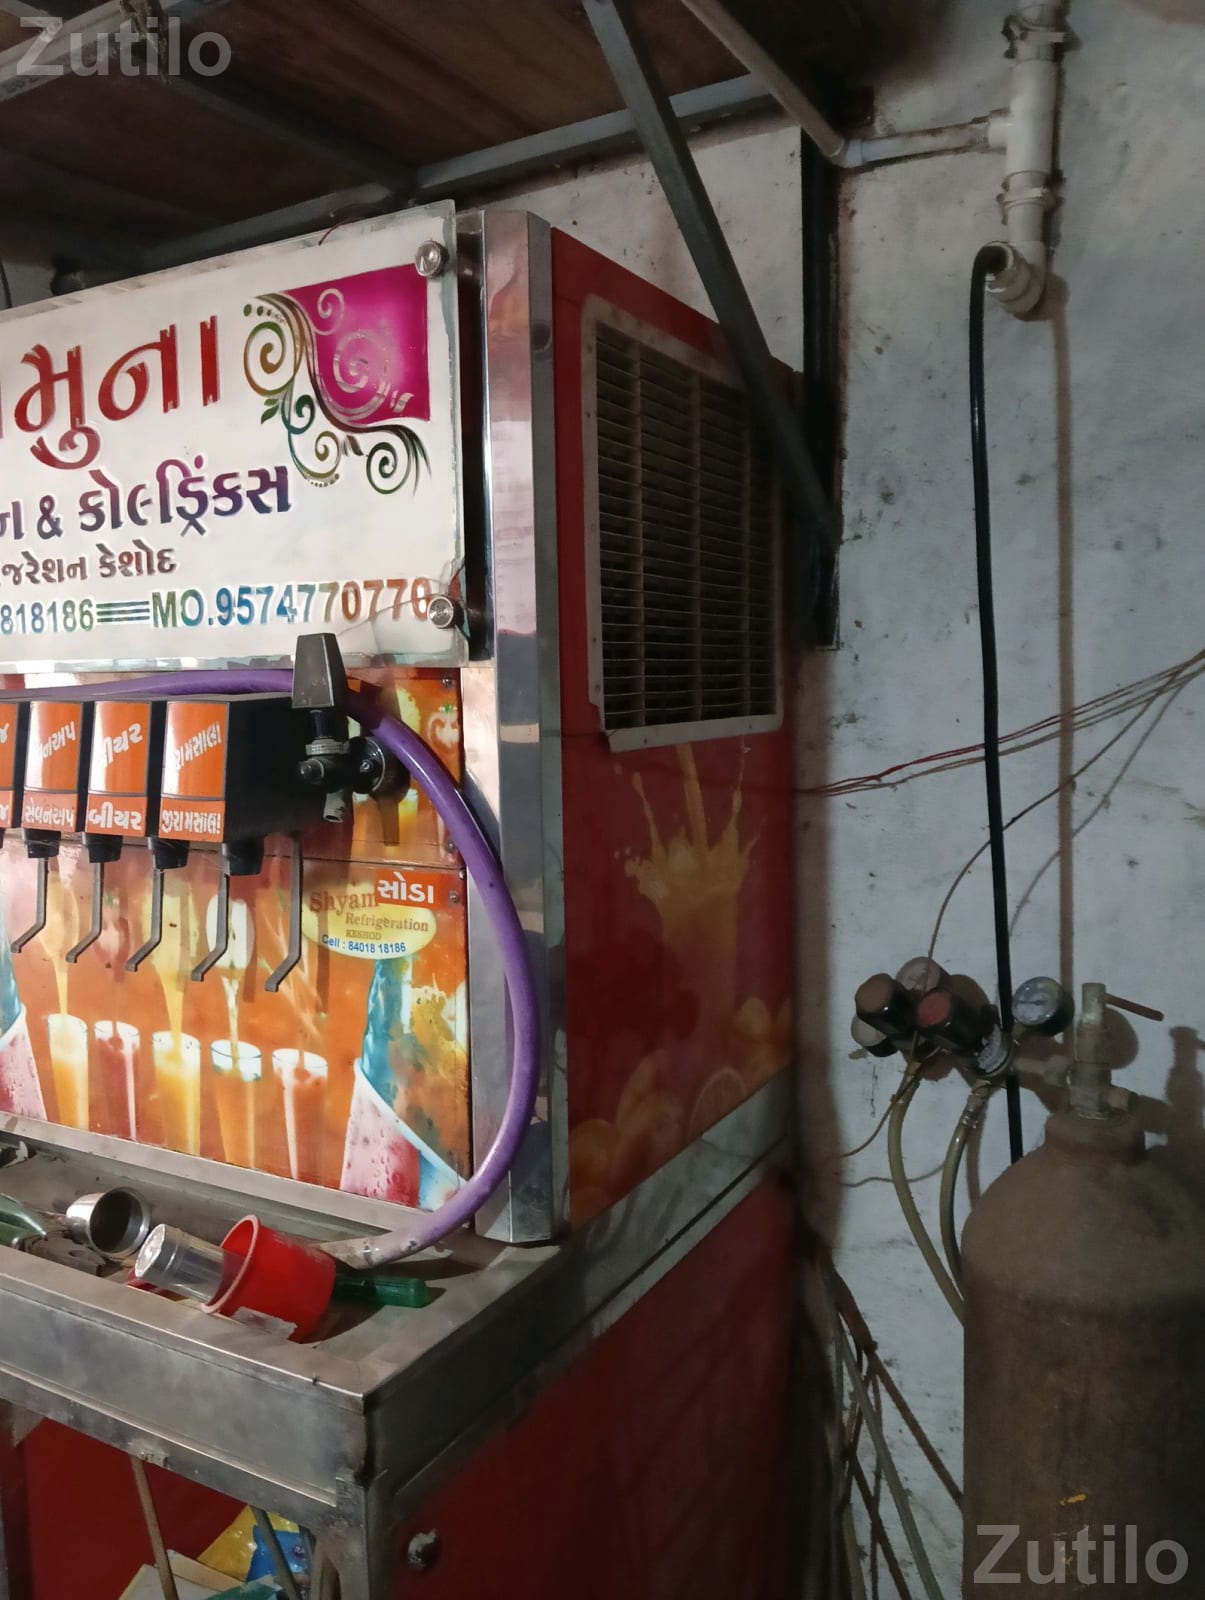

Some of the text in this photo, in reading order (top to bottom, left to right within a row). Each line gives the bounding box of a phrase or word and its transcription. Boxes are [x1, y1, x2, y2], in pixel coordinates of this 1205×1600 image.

[0, 315, 219, 470] મુના
[37, 494, 64, 540] &
[0, 551, 88, 586] જરેશન
[345, 912, 430, 932] Refrigeration
[347, 940, 376, 953] 84018
[379, 942, 407, 954] 18186
